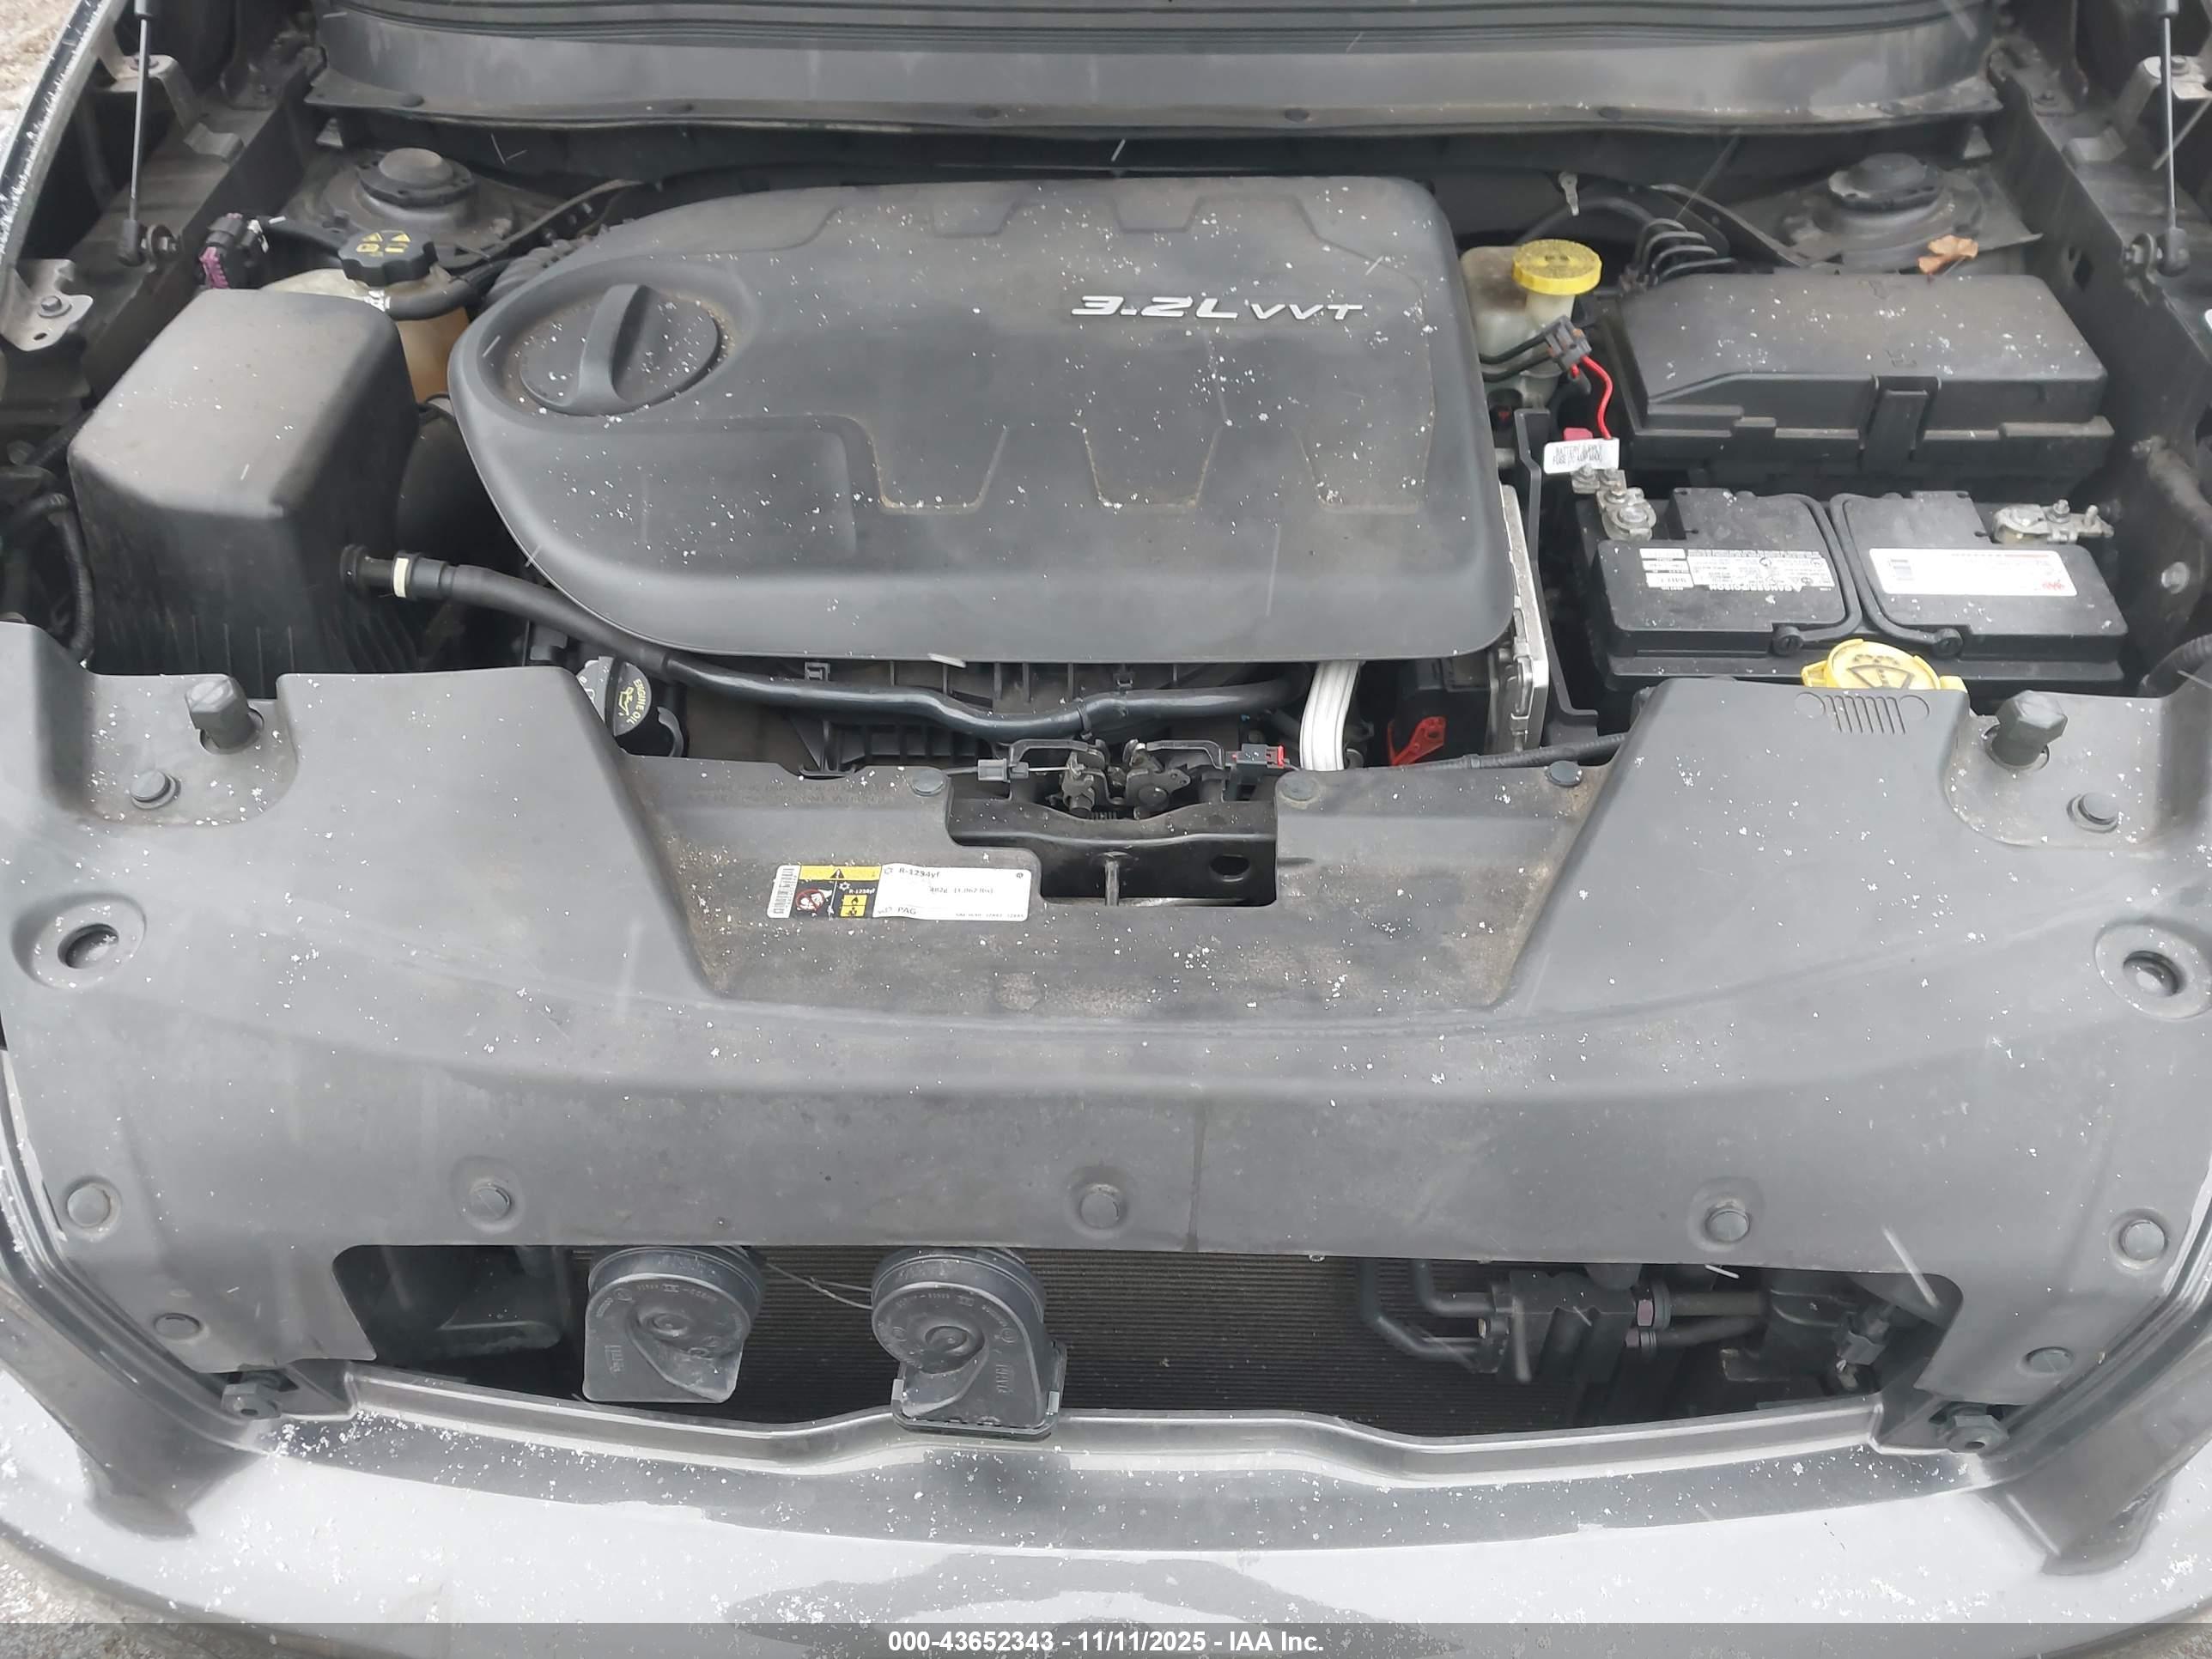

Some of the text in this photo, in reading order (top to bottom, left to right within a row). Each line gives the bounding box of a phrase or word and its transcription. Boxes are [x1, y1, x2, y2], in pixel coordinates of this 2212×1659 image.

[1071, 295, 1364, 320] 3.2L VVT
[626, 678, 647, 726] ENGINE OIL
[897, 906, 917, 915] PAG
